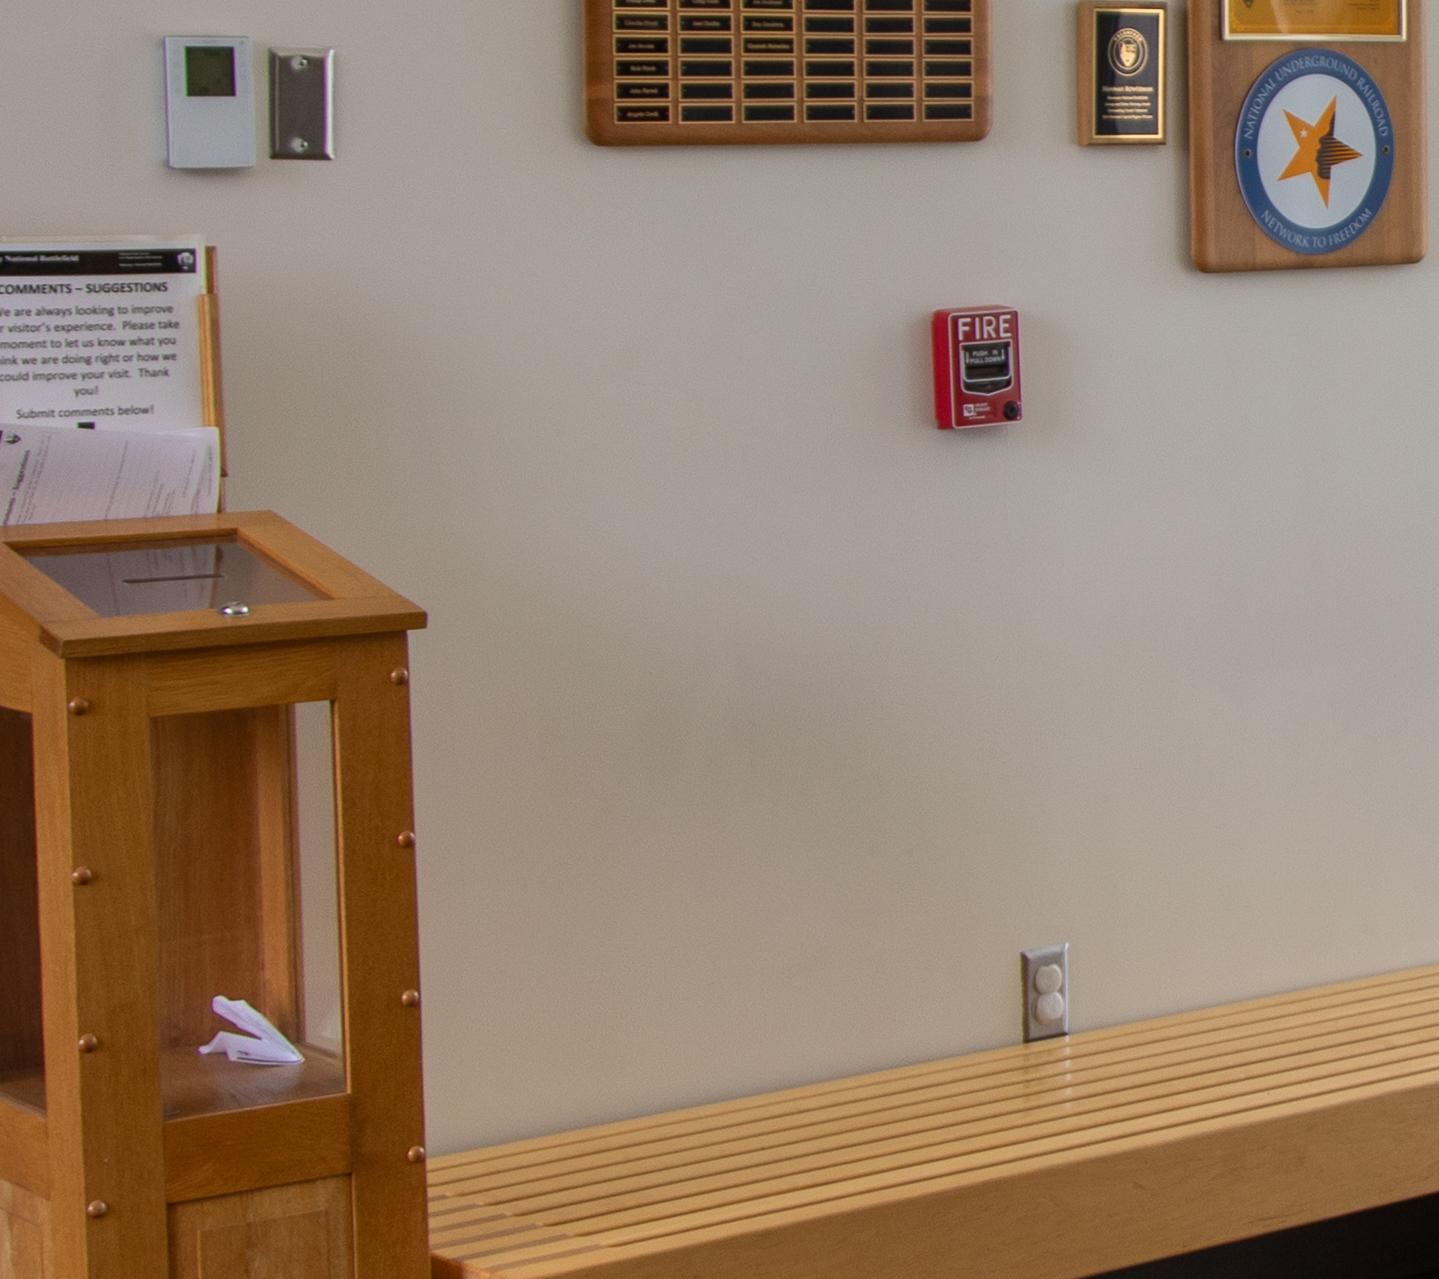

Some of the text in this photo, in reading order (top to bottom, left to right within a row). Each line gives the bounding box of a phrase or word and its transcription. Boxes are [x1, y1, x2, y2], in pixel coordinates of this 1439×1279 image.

[1243, 56, 1389, 140] NATIONAL UNDERGROUND RAILROAD
[1261, 207, 1373, 248] NETWORK TO FREEDOM
[86, 282, 168, 294] SUGGESTIONS
[13, 308, 32, 317] are
[35, 306, 72, 319] always
[75, 305, 114, 318] looking
[117, 307, 128, 316] to
[131, 305, 174, 318] improve
[7, 321, 51, 333] visitor's
[54, 322, 115, 336] experience.
[122, 320, 155, 330] Please
[158, 320, 180, 330] take
[958, 314, 1012, 340] FIRE
[0, 339, 47, 349] moment
[50, 339, 62, 348] to
[65, 337, 79, 348] let
[82, 339, 94, 348] us
[97, 337, 125, 347] know
[128, 336, 154, 347] what
[157, 338, 177, 350] you
[20, 357, 37, 365] we
[40, 357, 59, 365] are
[61, 354, 92, 368] doing
[95, 353, 120, 367] right
[122, 355, 134, 364] or
[136, 352, 159, 363] how
[162, 354, 177, 363] we
[0, 367, 170, 383] could improve your visit. Thank
[73, 385, 98, 398] you!
[16, 405, 154, 419] Submit comments below!
